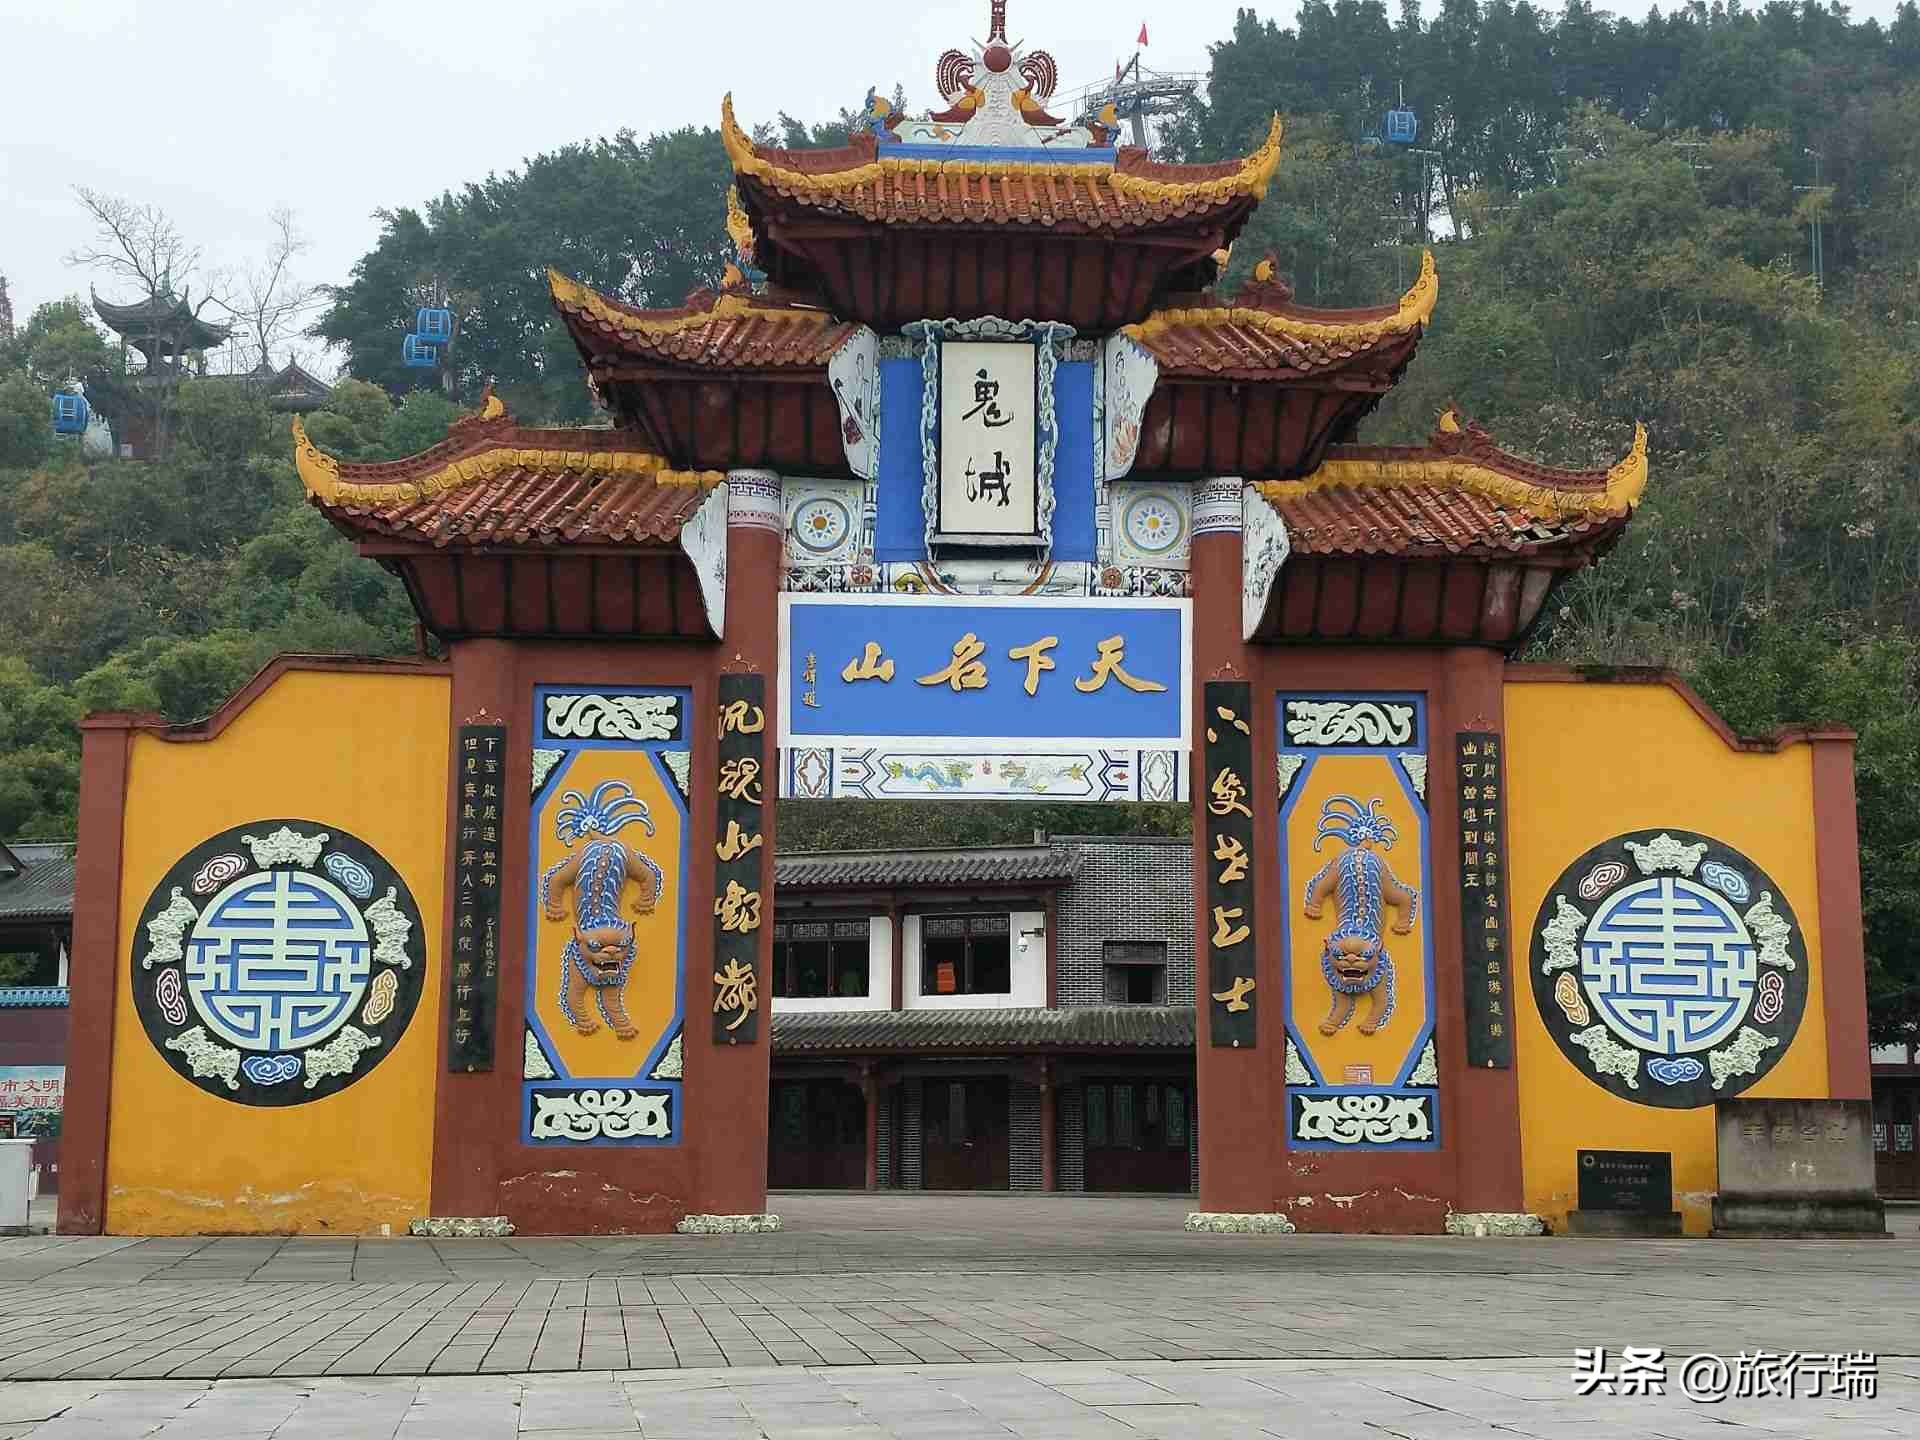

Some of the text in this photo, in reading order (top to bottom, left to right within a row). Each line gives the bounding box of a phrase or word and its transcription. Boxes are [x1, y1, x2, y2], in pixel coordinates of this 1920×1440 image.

[961, 368, 1015, 507] 鬼城
[841, 632, 1169, 697] 天下名山
